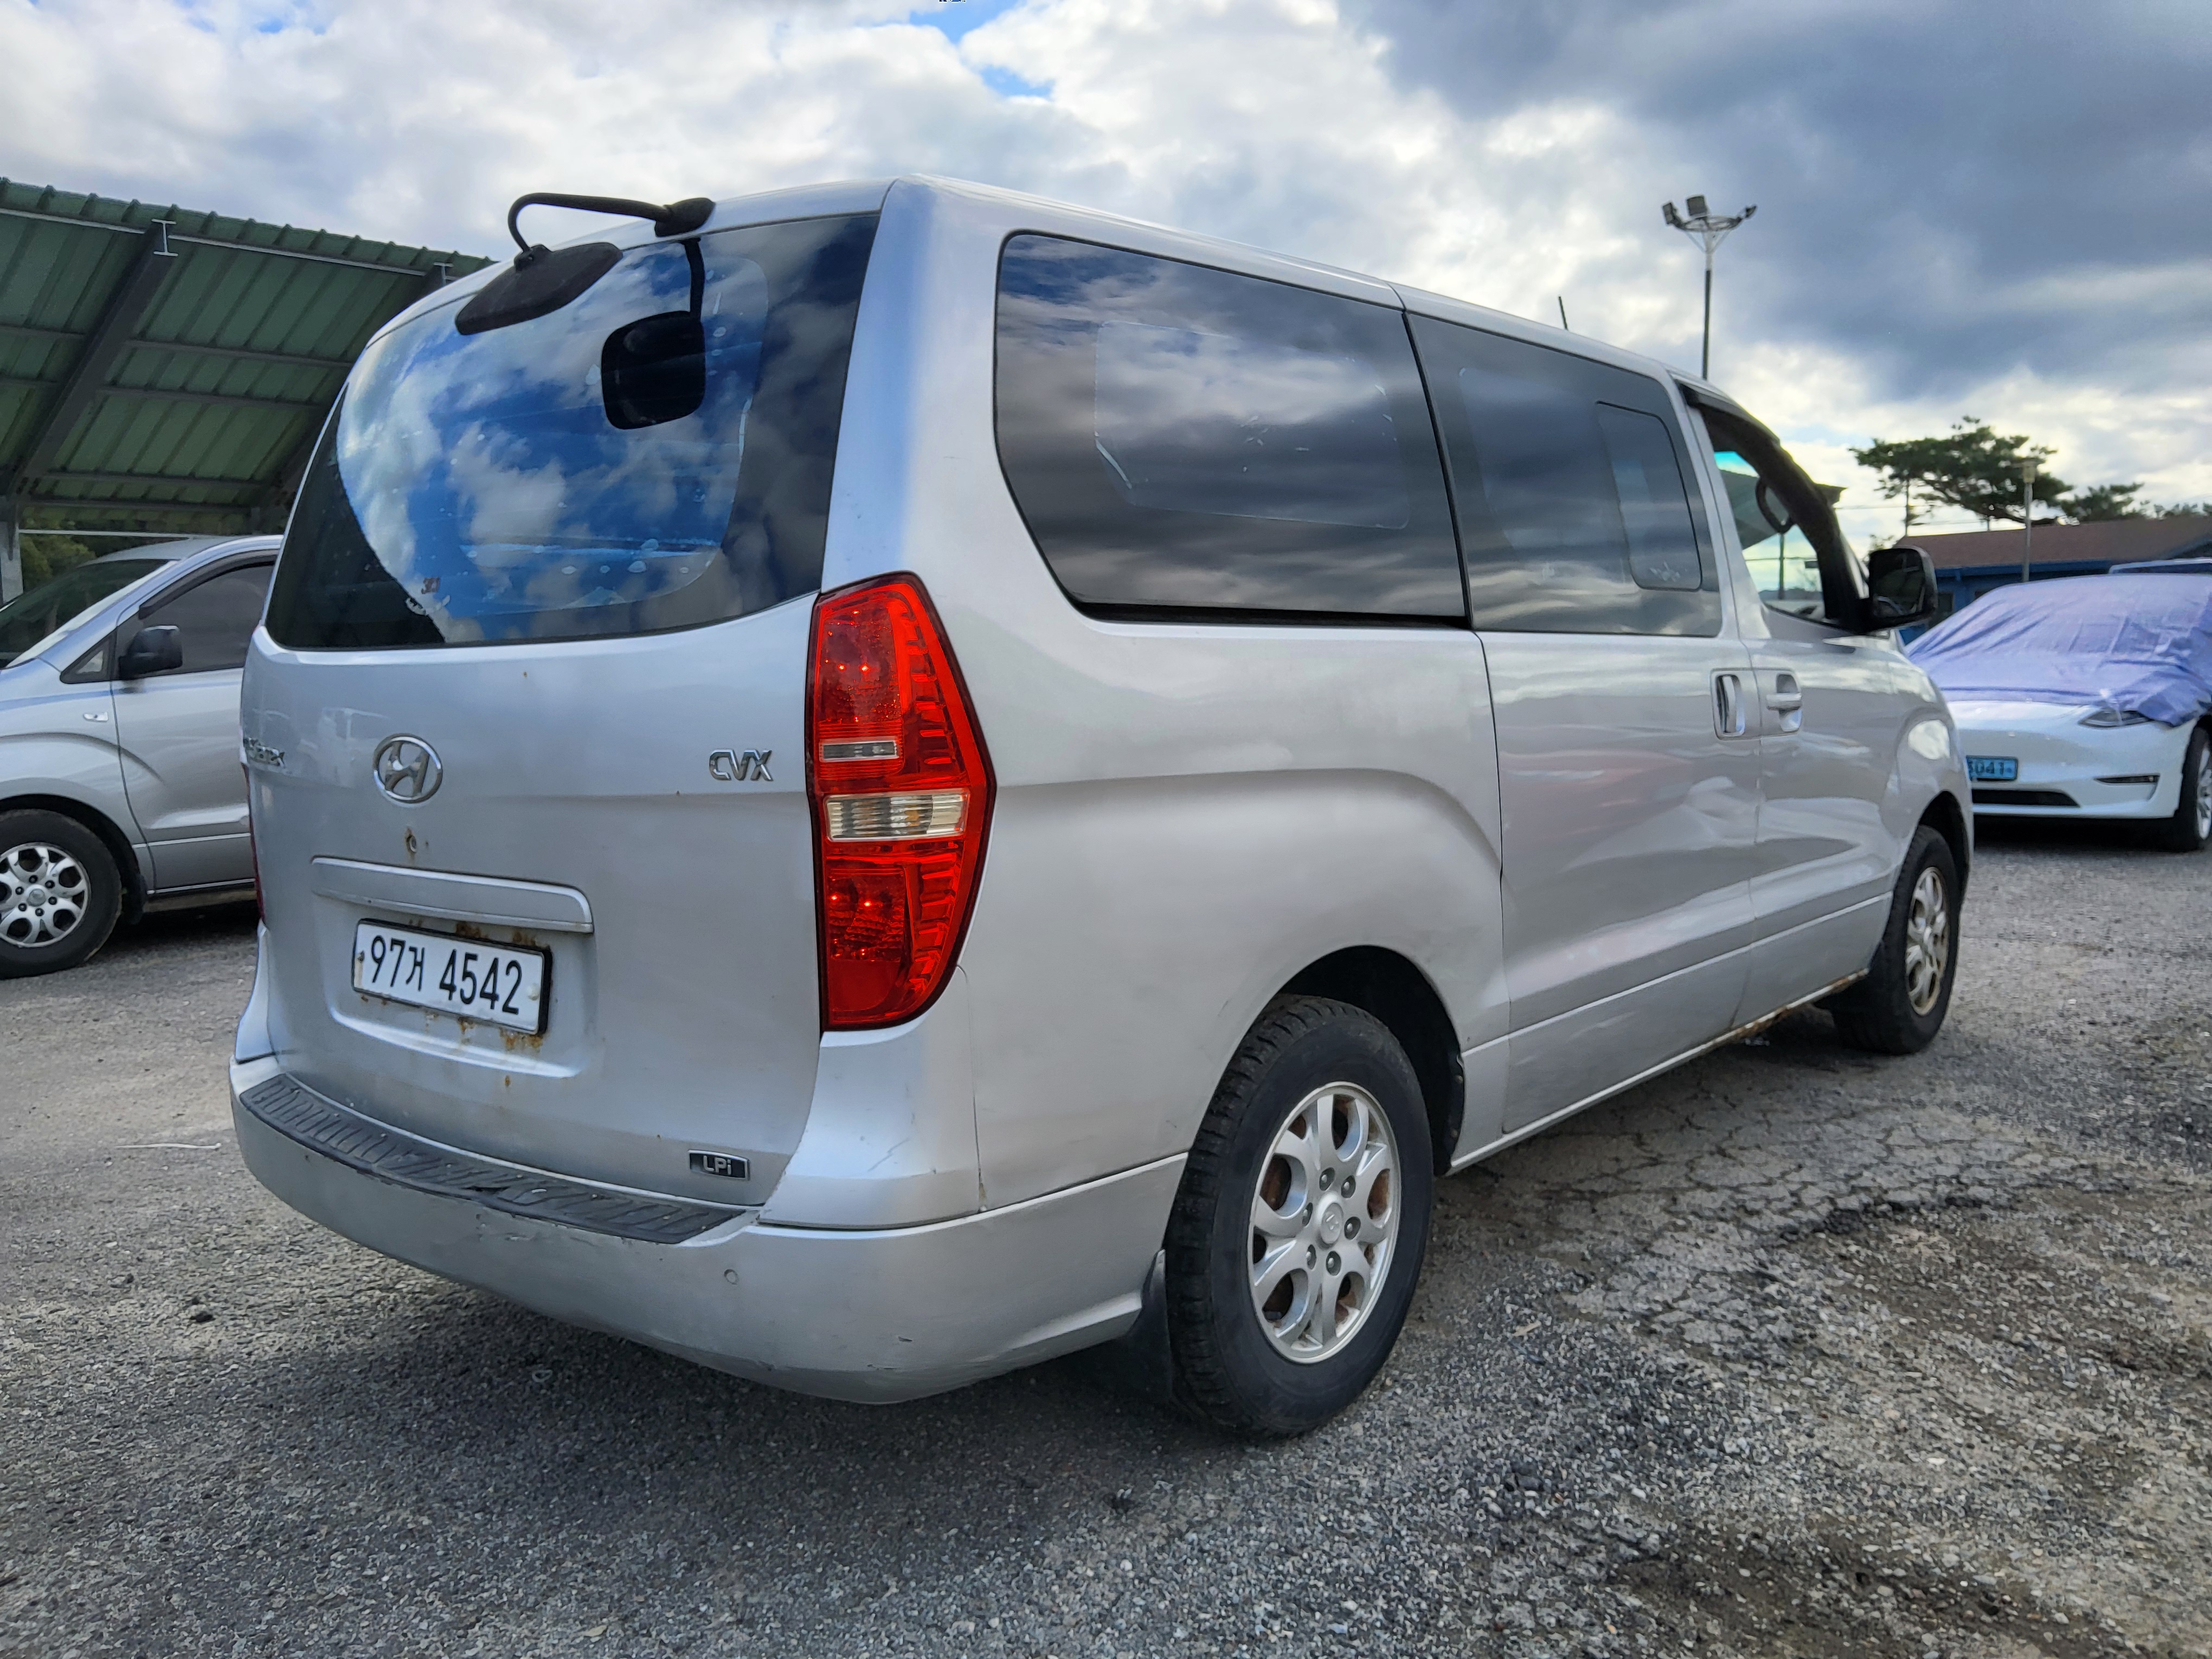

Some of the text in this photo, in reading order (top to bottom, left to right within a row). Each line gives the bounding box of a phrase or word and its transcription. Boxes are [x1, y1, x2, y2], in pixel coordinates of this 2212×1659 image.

[709, 749, 774, 781] CVX
[371, 935, 522, 1015] 97거 4542
